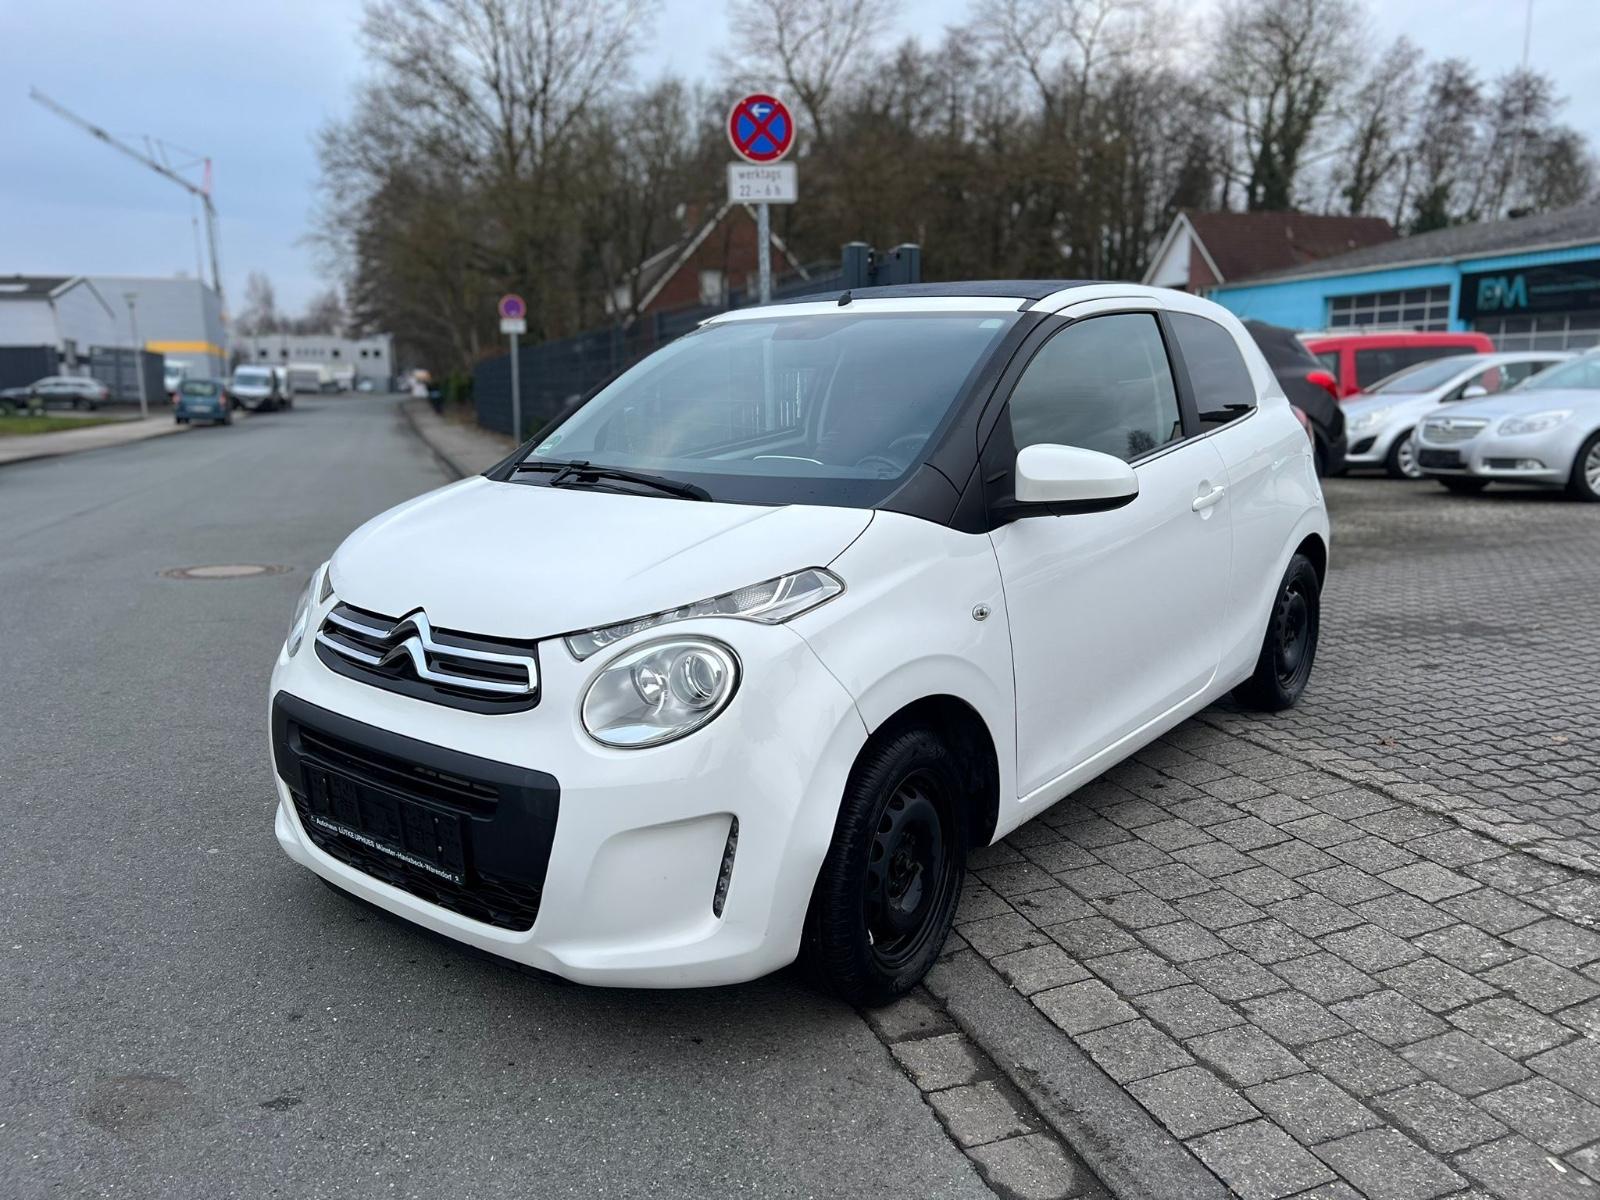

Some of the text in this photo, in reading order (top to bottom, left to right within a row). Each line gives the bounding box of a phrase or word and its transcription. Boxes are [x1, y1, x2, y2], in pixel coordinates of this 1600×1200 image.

[738, 169, 782, 182] werktags
[739, 184, 751, 197] 22
[765, 184, 771, 196] 6
[775, 185, 782, 196] h
[316, 817, 338, 832] Autohaus
